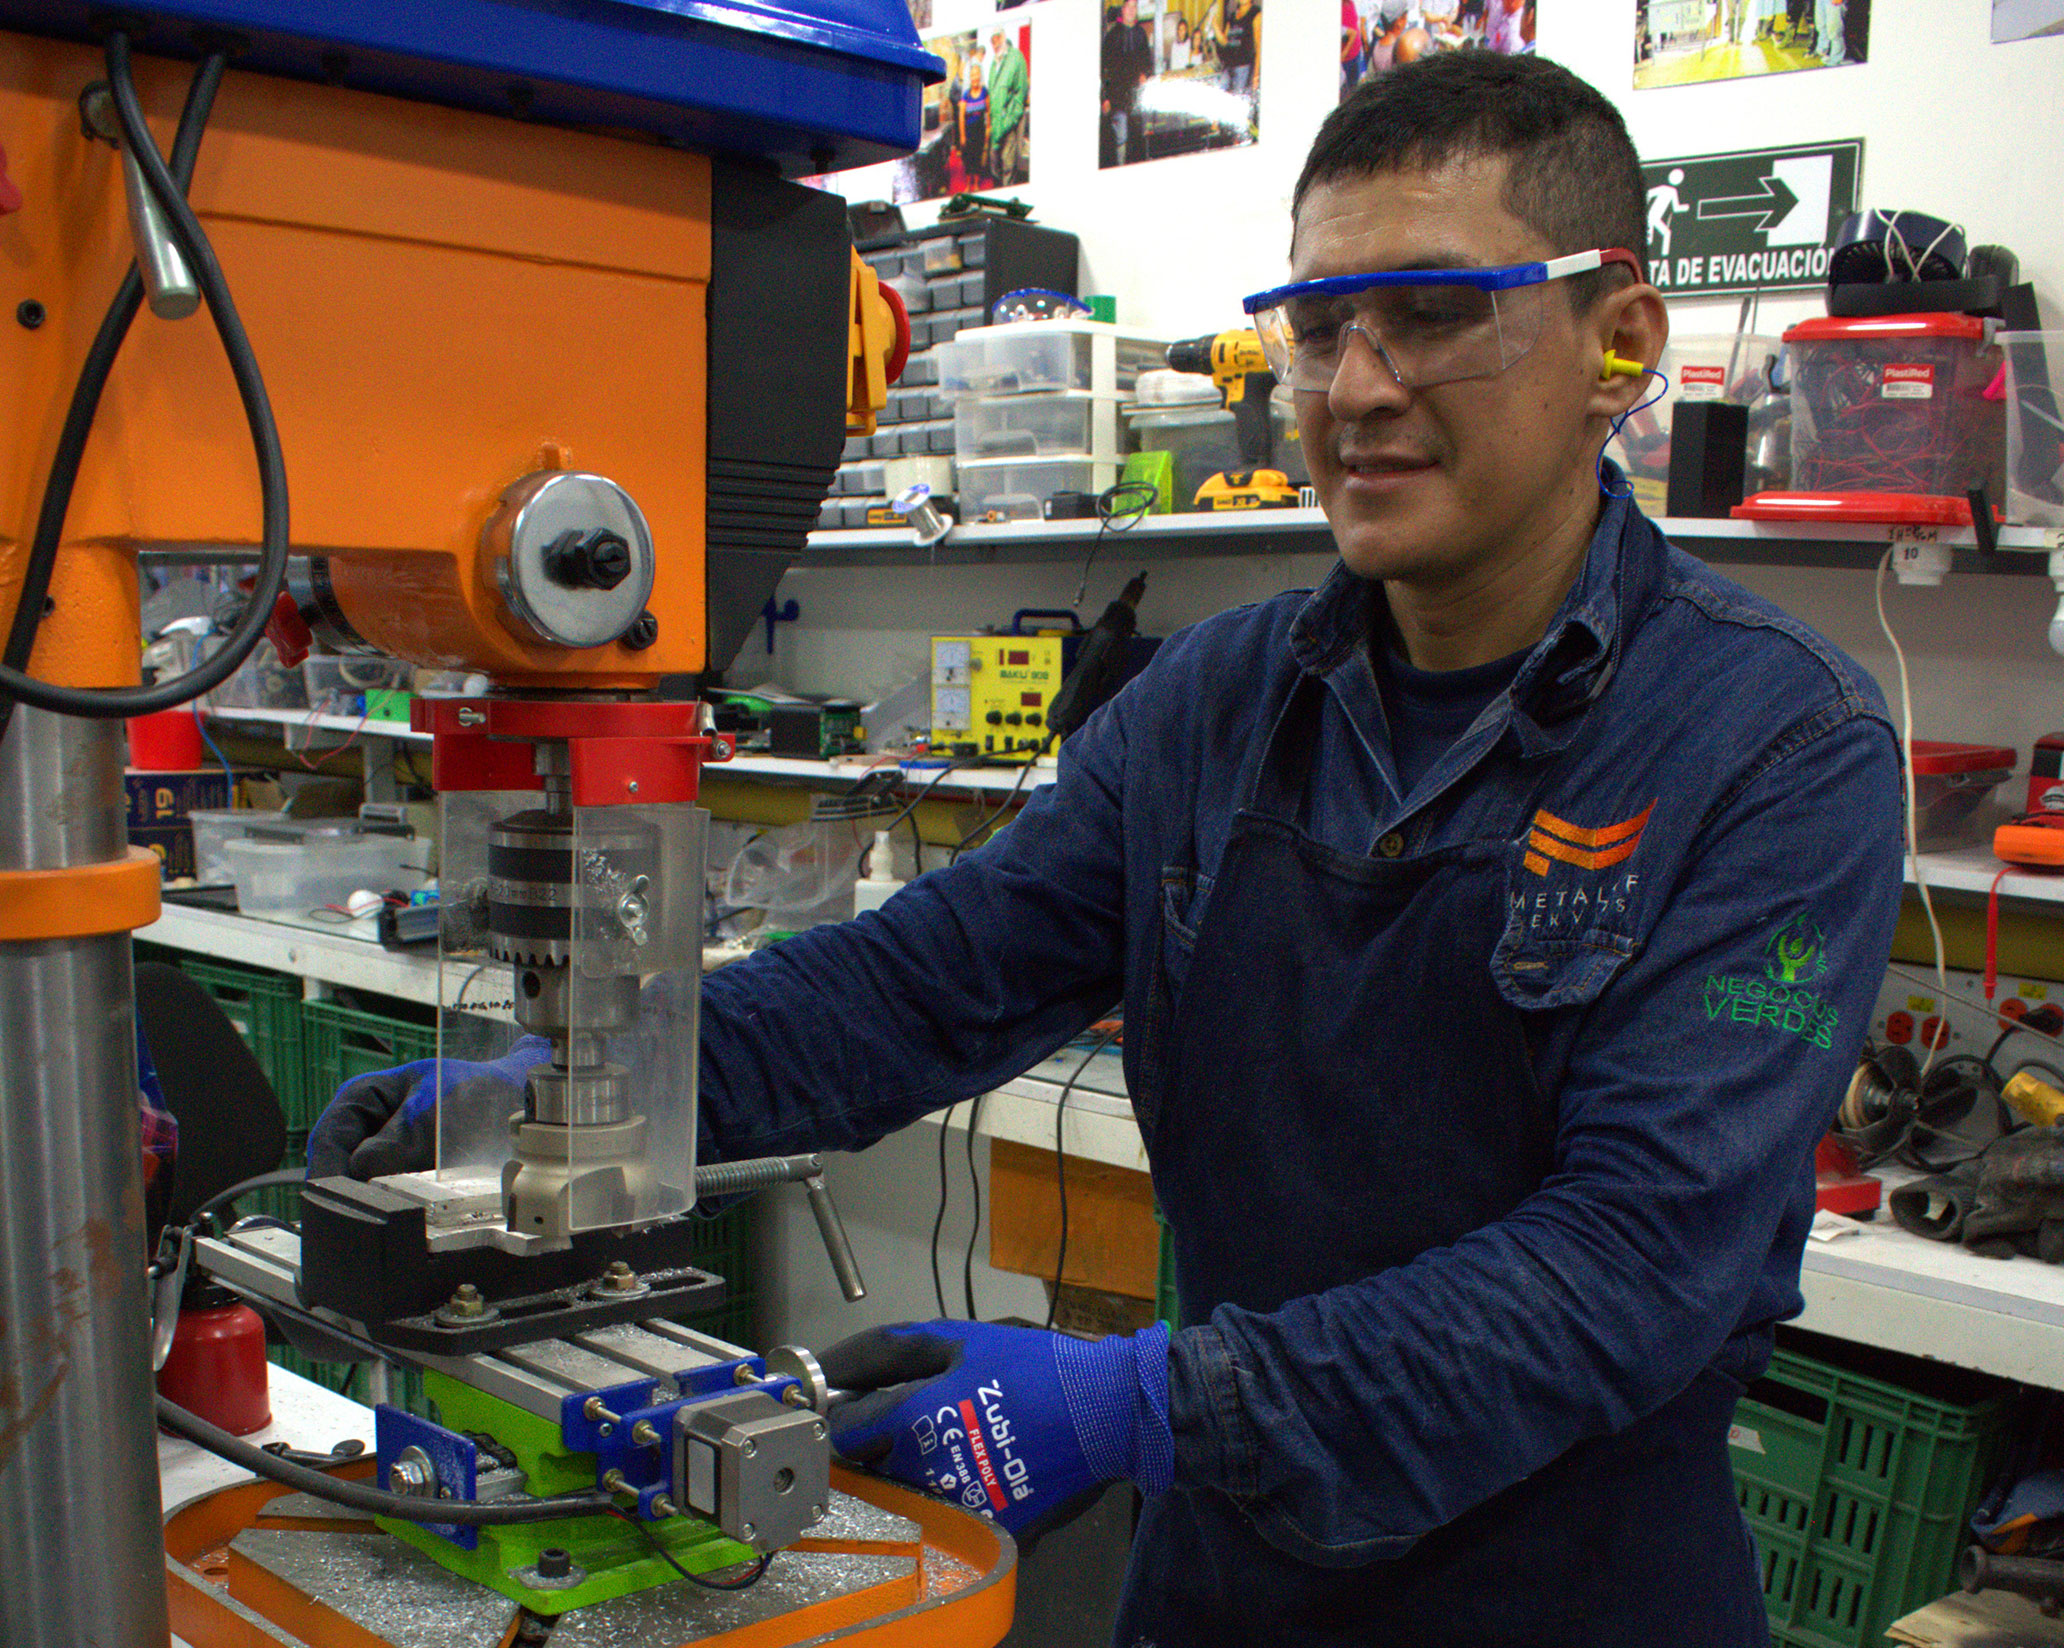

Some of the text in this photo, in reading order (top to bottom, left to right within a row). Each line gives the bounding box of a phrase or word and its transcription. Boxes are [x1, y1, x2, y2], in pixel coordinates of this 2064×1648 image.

[1648, 258, 1671, 287] TA
[1676, 256, 1704, 285] DE
[1885, 367, 1931, 379] PlastiRed
[1703, 994, 1832, 1050] VERDES
[950, 1444, 964, 1464] EN
[968, 1428, 988, 1459] FLEX
[978, 1458, 998, 1487] POLY
[955, 1463, 972, 1484] 388
